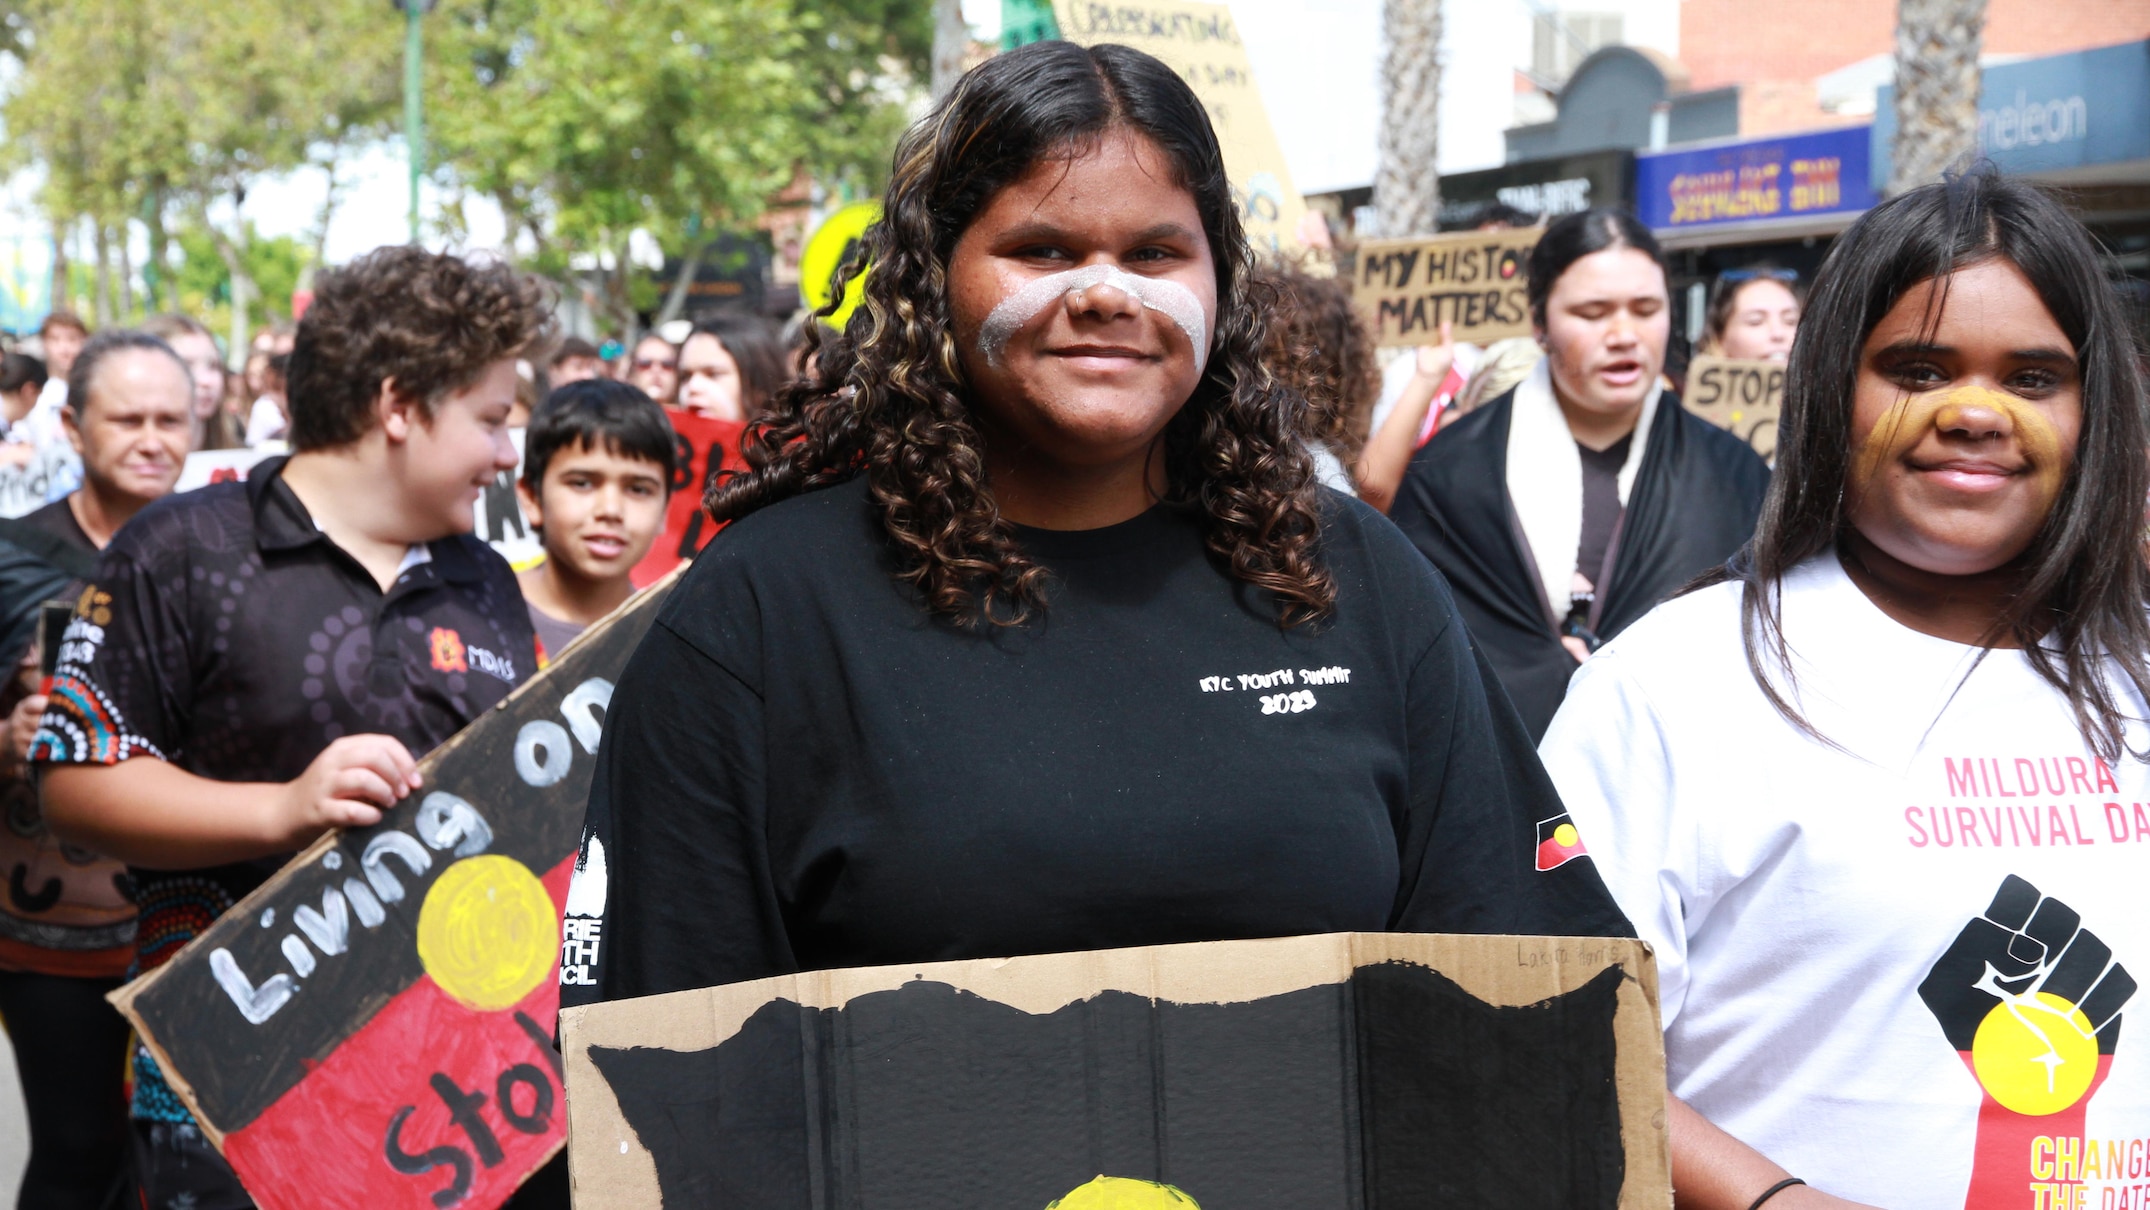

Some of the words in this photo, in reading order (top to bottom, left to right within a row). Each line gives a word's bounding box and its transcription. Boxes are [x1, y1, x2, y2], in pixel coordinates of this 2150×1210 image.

[1364, 249, 1420, 289] MY
[1377, 289, 1525, 335] MATTERS
[1696, 366, 1783, 406] STOP
[1237, 669, 1295, 691] YOUTH
[1299, 665, 1352, 686] SUMMIT
[1258, 689, 1318, 716] 2023
[1944, 756, 2120, 798] MILDURA
[1904, 804, 2095, 848] SURVIVAL
[2103, 802, 2150, 844] DA
[208, 791, 495, 1025] Living
[2029, 1182, 2090, 1210] THE
